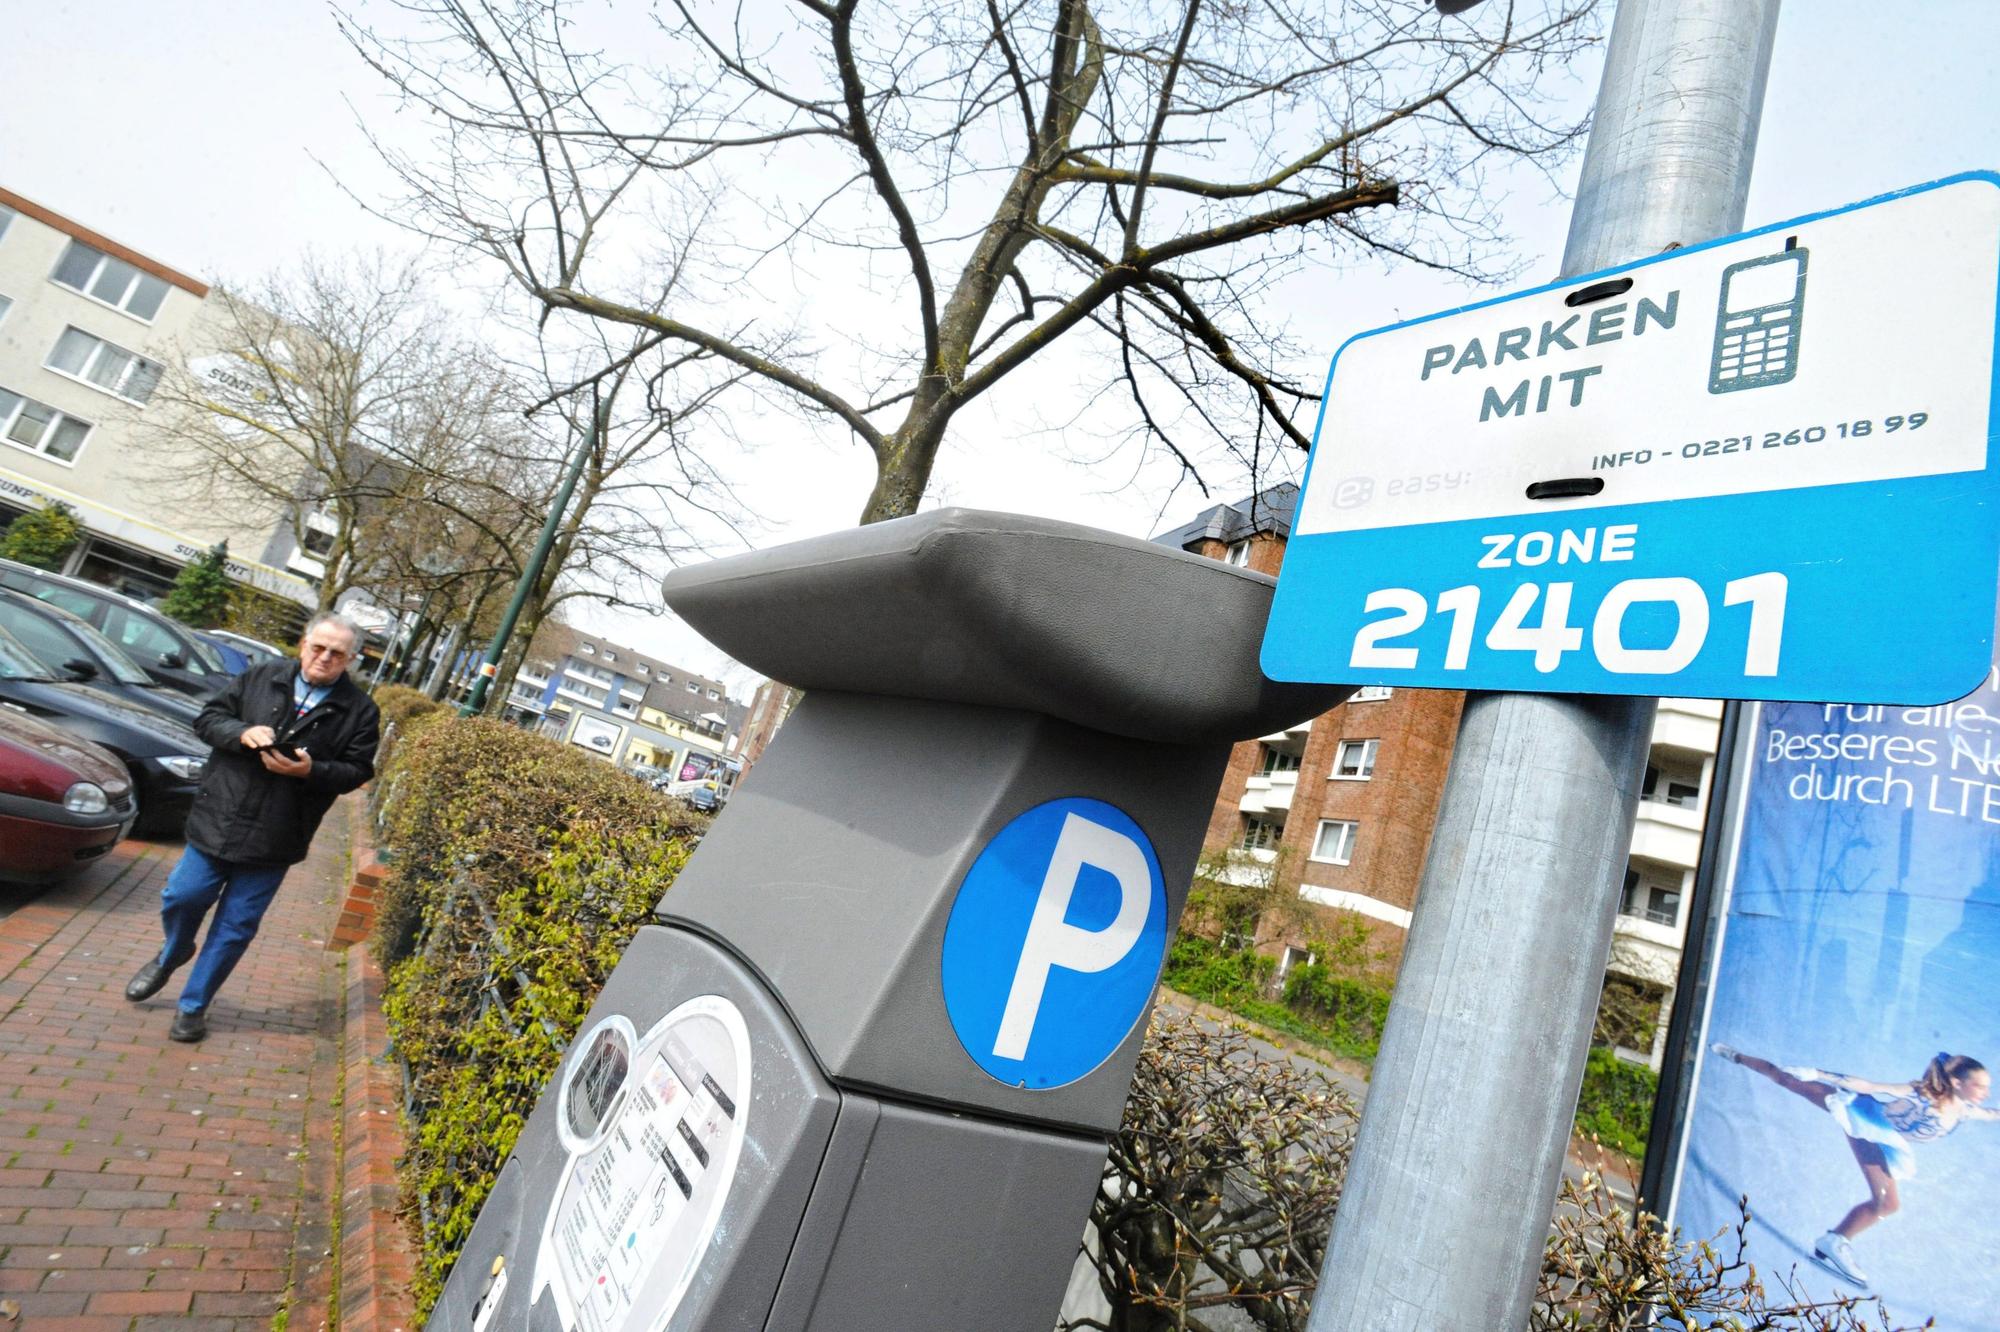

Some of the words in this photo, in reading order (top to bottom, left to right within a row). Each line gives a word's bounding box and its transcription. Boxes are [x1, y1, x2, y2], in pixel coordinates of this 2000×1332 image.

[1421, 289, 1680, 381] PARKEN
[1479, 365, 1603, 422] MIT
[1592, 450, 1652, 470] INFO
[1682, 435, 1752, 459] 0221
[1762, 426, 1827, 449] 260
[1837, 420, 1873, 438] 18
[1885, 412, 1929, 433] 99
[1477, 524, 1638, 568] ZONE
[1349, 571, 1788, 677] 21401
[1767, 730, 1938, 767] Besseres
[1789, 763, 1914, 808] durch
[992, 812, 1151, 1061] P
